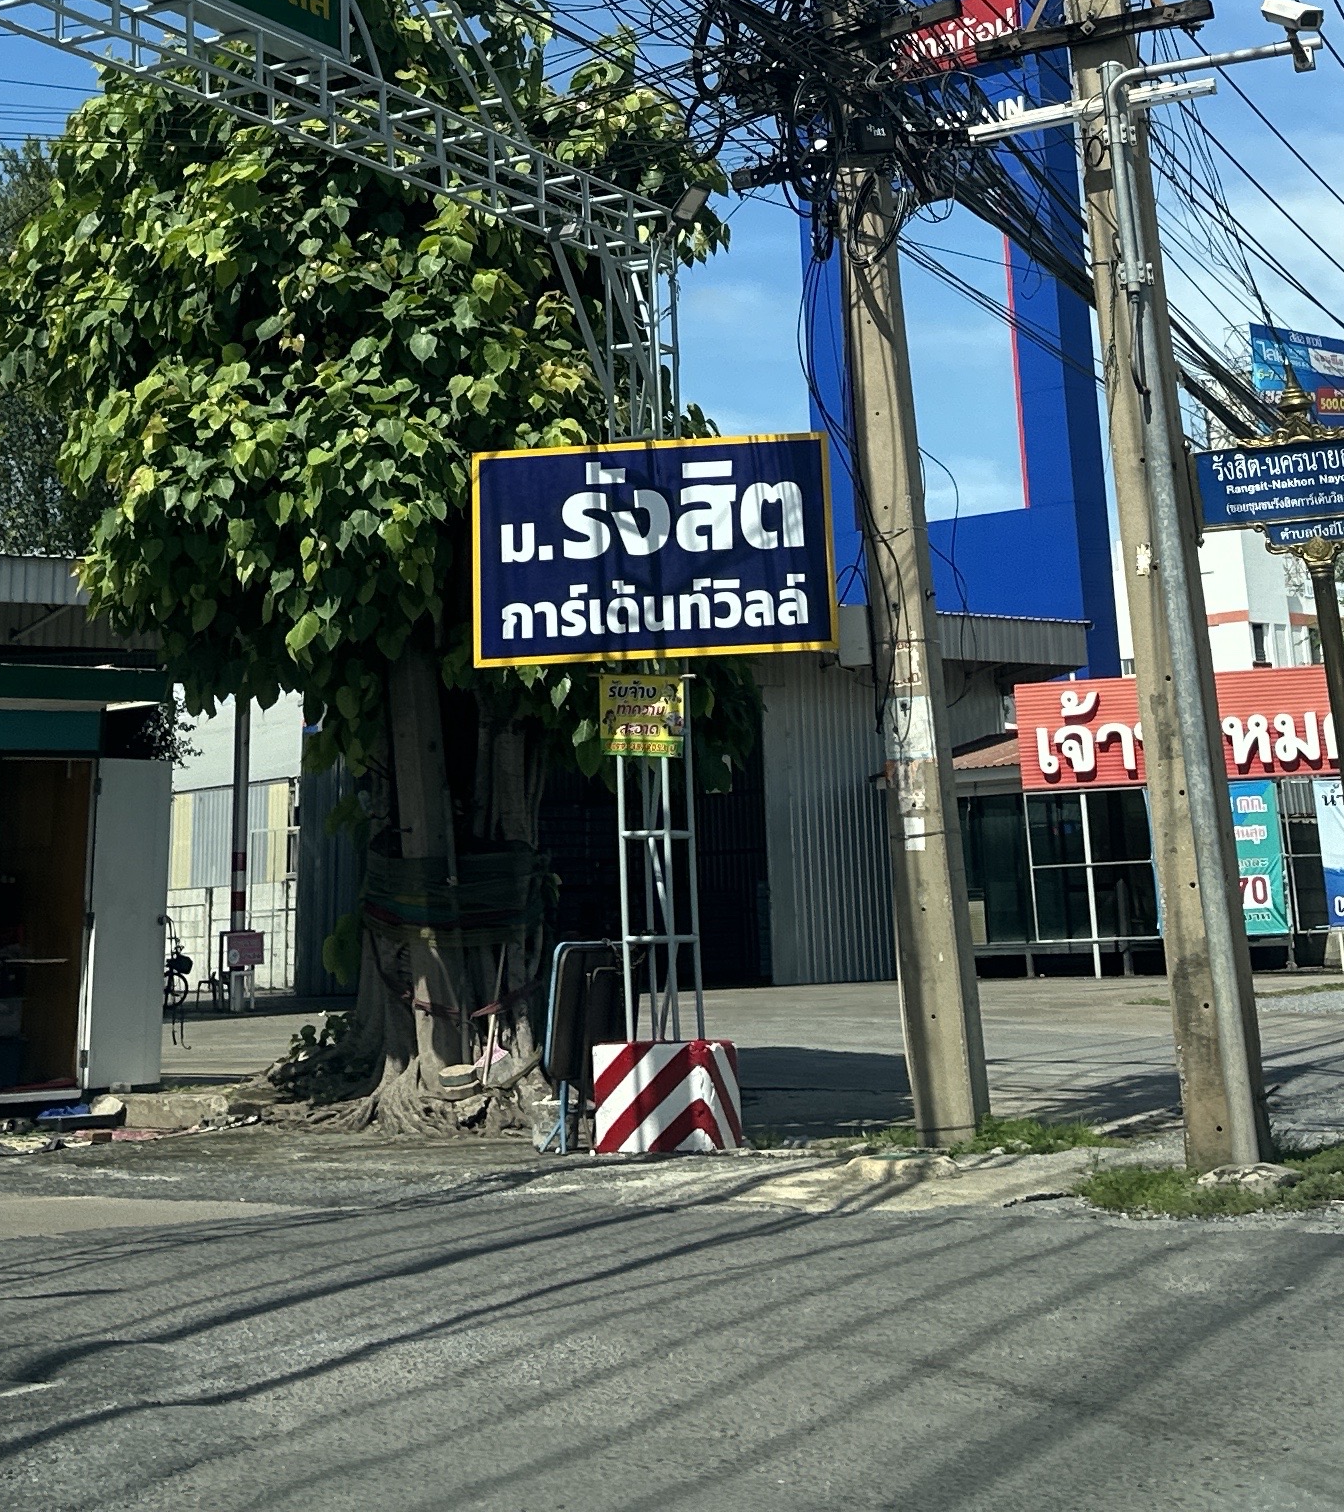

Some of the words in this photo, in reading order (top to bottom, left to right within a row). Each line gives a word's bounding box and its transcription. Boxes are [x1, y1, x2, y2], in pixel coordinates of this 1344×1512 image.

[1226, 476, 1315, 495] Rangsit-Nakhon
[501, 573, 809, 639] การ์เด้นท์วิลล์
[608, 680, 657, 699] รับจ้าง
